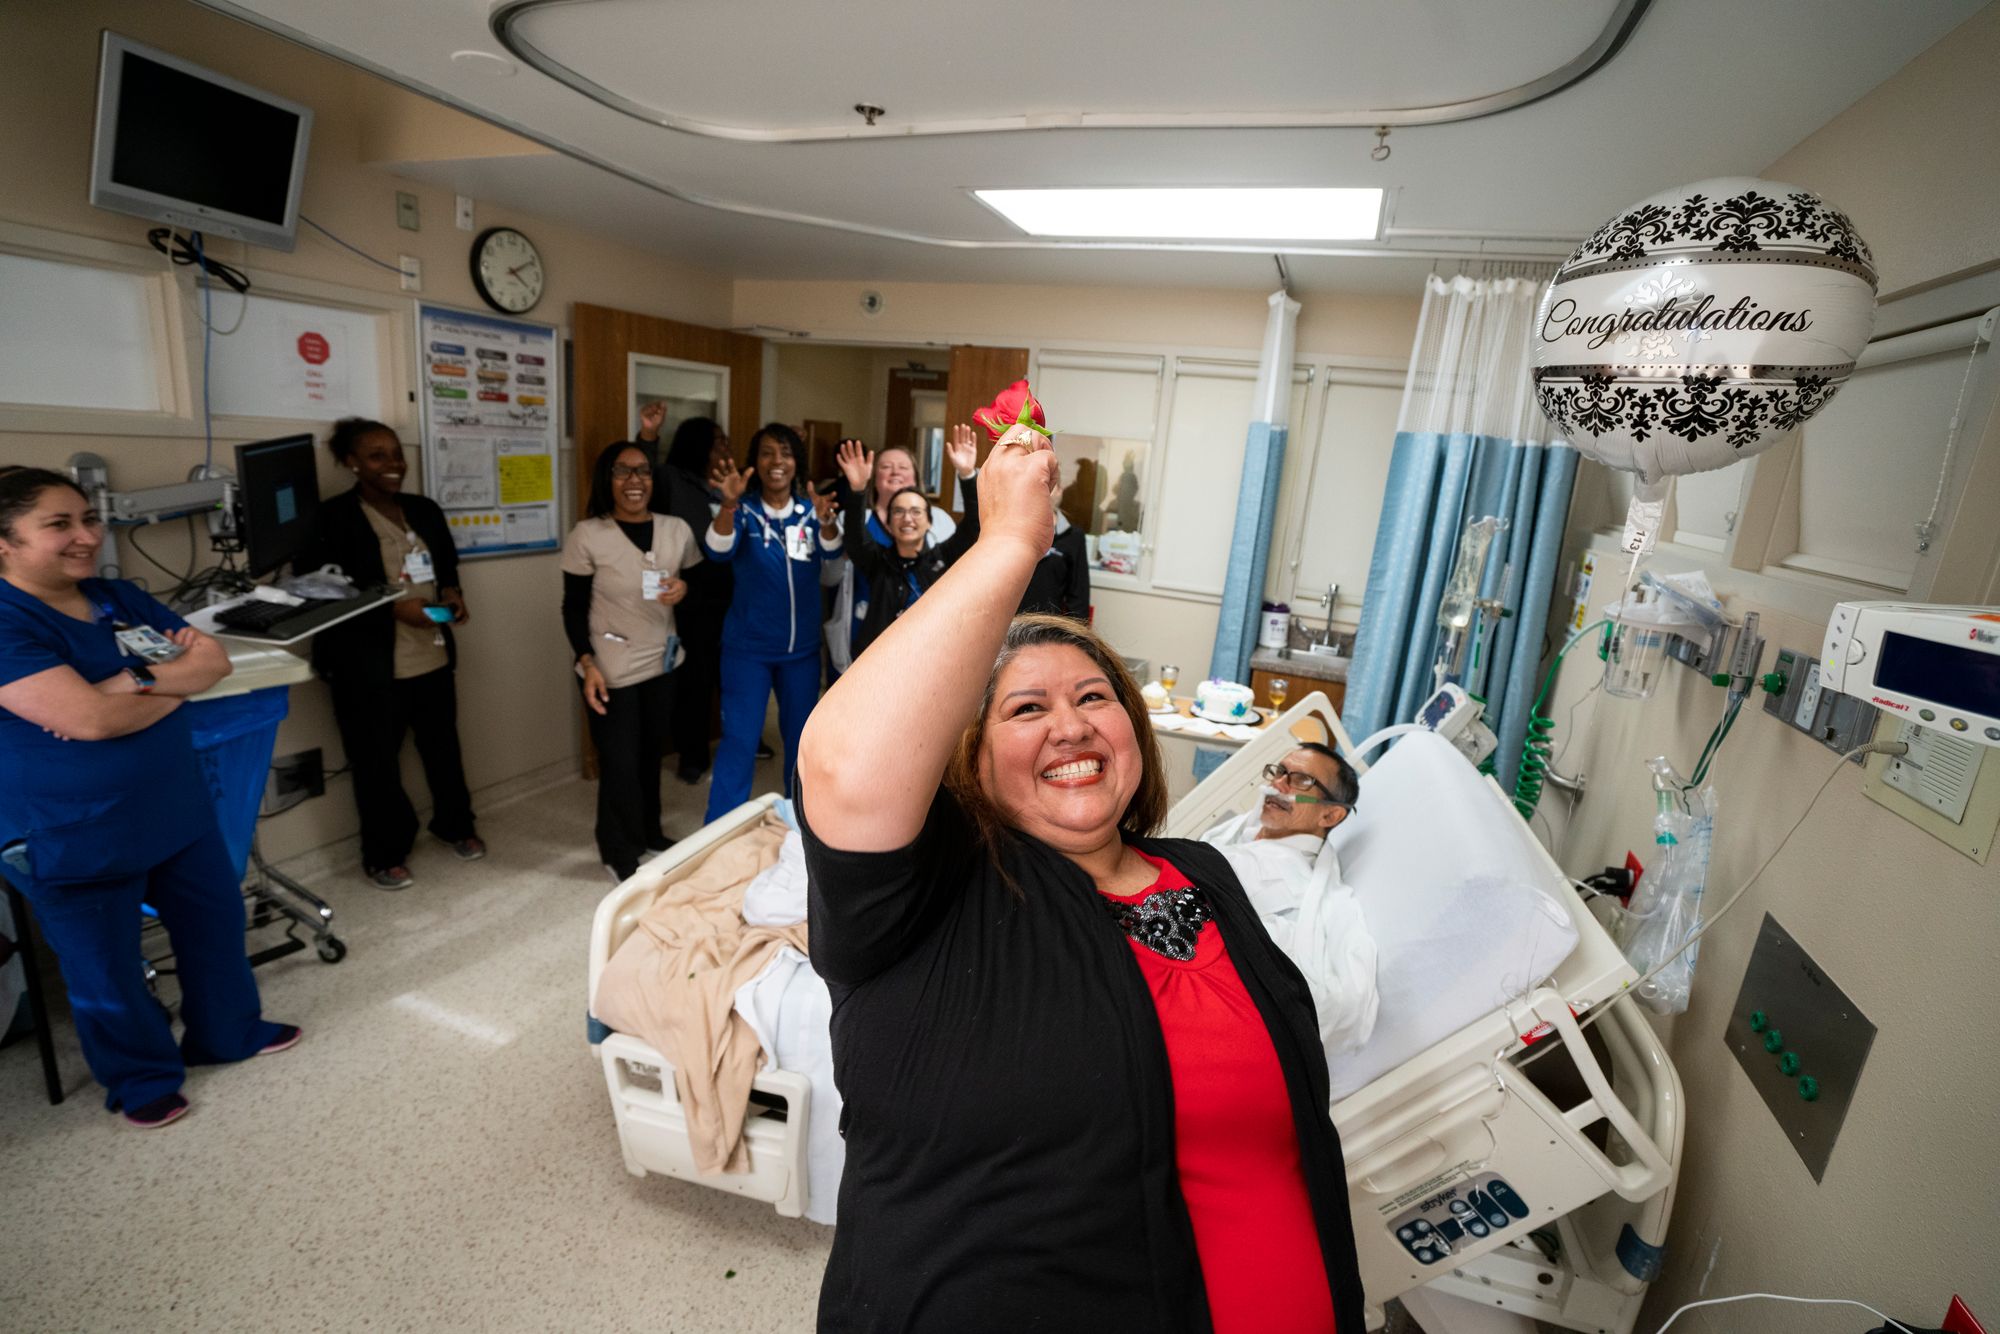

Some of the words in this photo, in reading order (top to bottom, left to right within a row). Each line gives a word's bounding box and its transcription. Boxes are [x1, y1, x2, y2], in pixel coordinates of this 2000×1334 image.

[1541, 294, 1813, 350] Congratulations
[1629, 530, 1646, 551] 113
[1420, 1188, 1457, 1213] stryker
